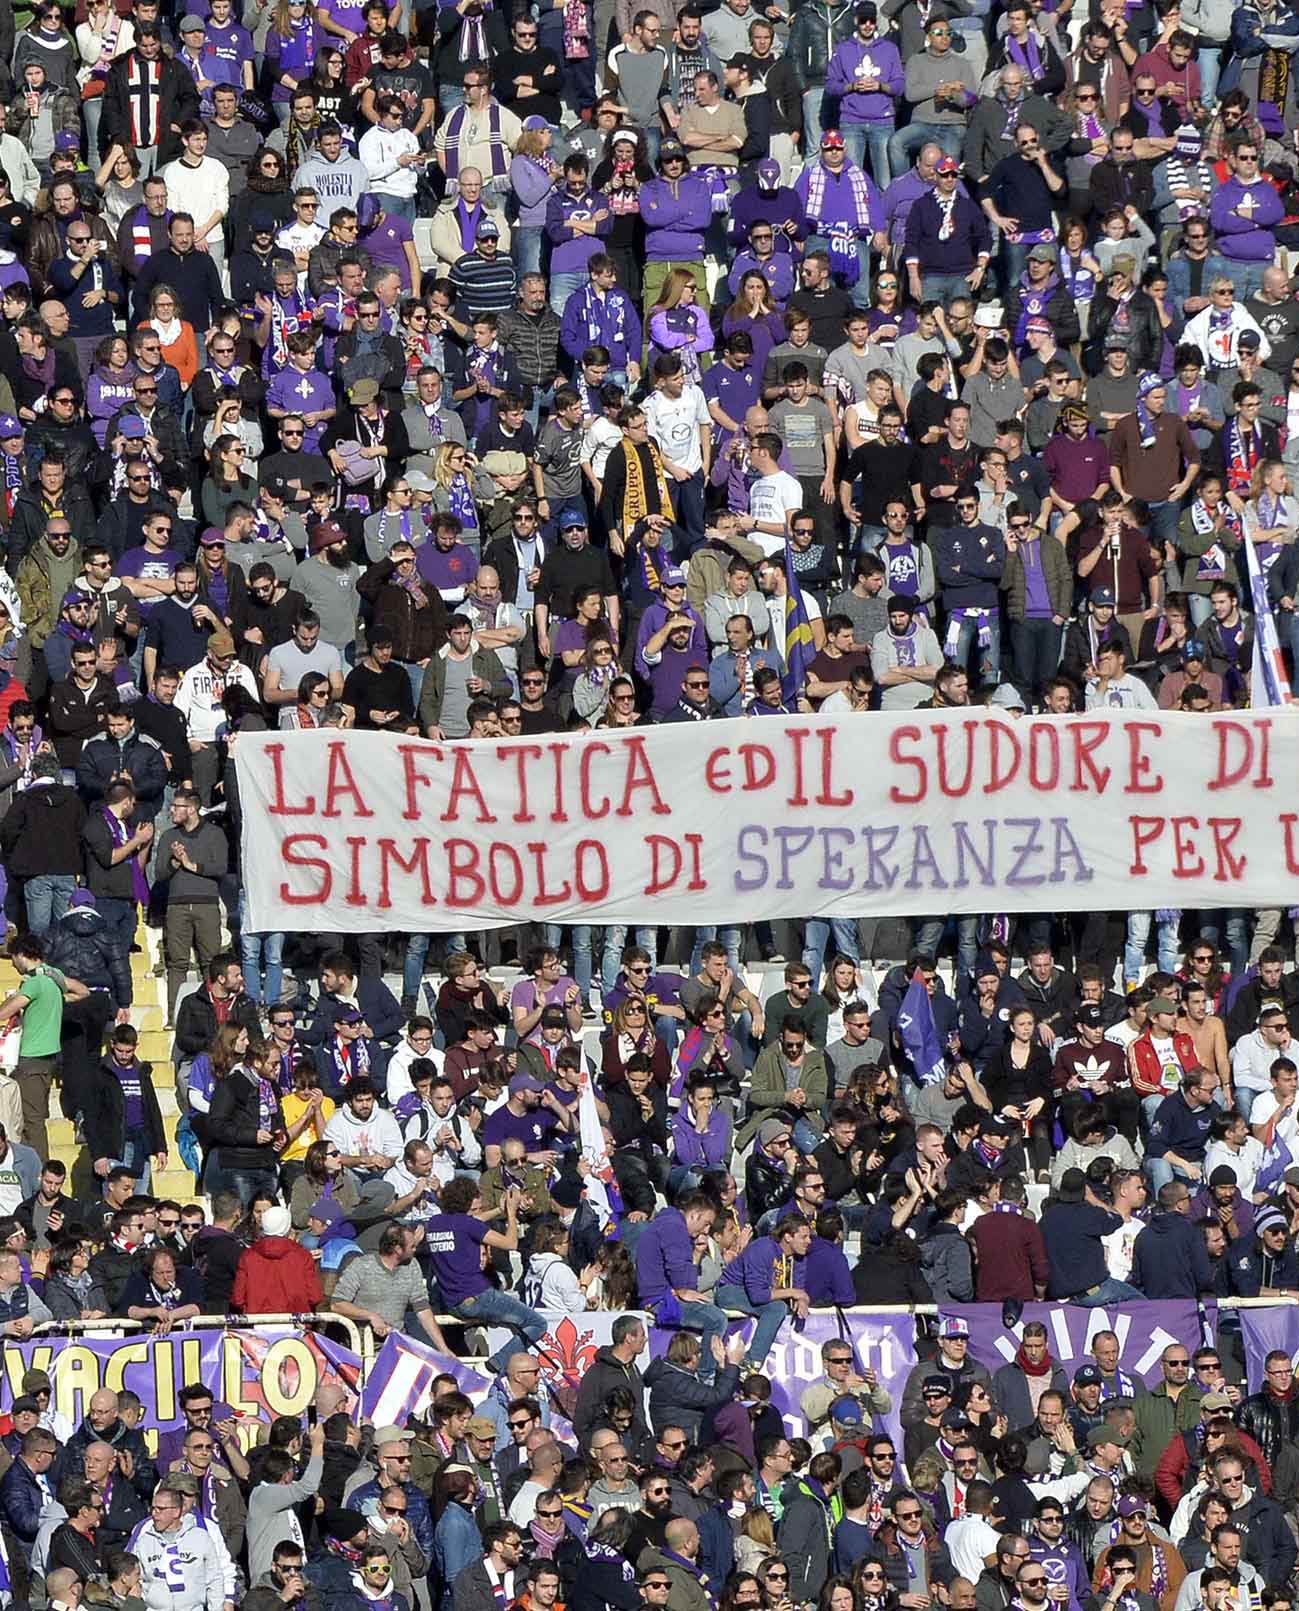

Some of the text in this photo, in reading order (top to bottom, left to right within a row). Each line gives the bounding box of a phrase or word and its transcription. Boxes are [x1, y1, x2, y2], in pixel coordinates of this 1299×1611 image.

[314, 173, 353, 187] MOLESTIA
[317, 184, 353, 198] VIOLA
[627, 459, 645, 520] GRUPPO
[192, 674, 244, 696] FIRZE
[264, 743, 375, 821] LA
[396, 735, 673, 825] FATICA
[888, 718, 1164, 805] SUDORE
[1207, 719, 1274, 791] DI
[278, 832, 612, 910] SIMBOLO
[643, 832, 708, 896] DI
[733, 816, 1095, 892] SPERANZA
[1129, 815, 1248, 882] PER
